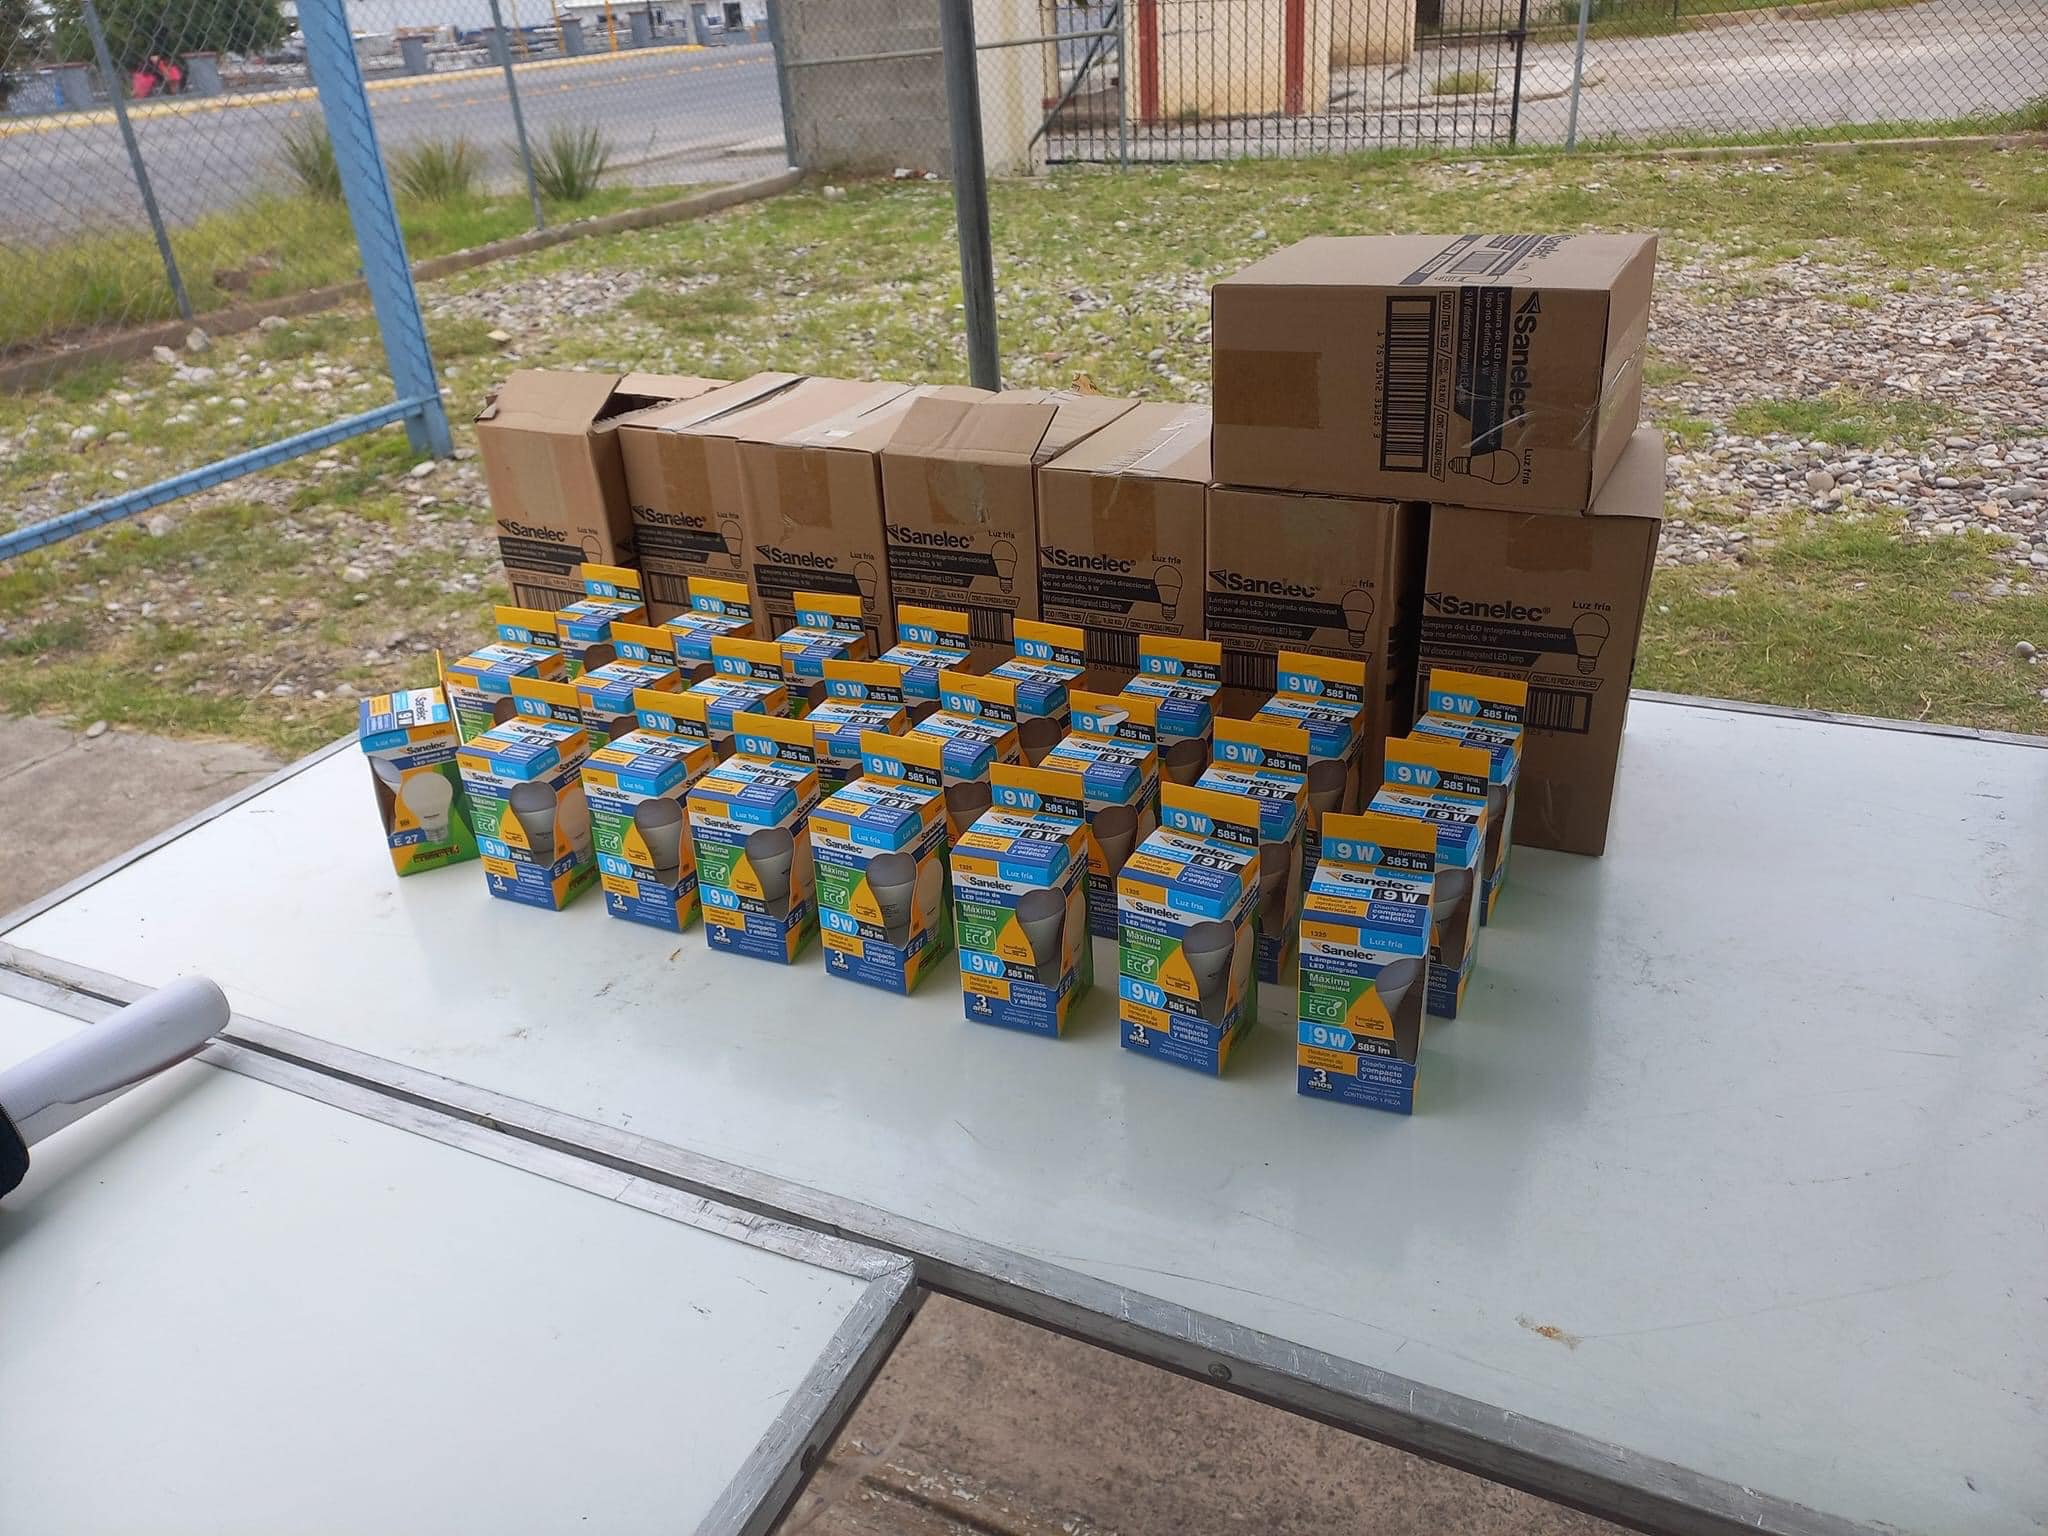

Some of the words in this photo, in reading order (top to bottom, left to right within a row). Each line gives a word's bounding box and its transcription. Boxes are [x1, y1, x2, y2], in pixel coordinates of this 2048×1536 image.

[1376, 344, 1384, 355] 75
[1508, 315, 1537, 421] Sanelec
[1523, 448, 1533, 465] Luz
[645, 508, 704, 528] Sanelec
[511, 522, 565, 542] Sanelec
[900, 527, 970, 548] Sanelec
[771, 548, 834, 569] Sanelec
[1055, 549, 1131, 573] Sanelec
[1443, 596, 1543, 622] Sanelec
[1573, 601, 1591, 609] Luz
[909, 628, 918, 640] 9
[920, 629, 932, 642] W
[1466, 624, 1481, 632] LED
[1024, 643, 1034, 655] 9
[1036, 644, 1047, 658] W
[1056, 653, 1070, 662] 585
[1071, 656, 1081, 665] lm
[723, 660, 732, 672] 9
[734, 660, 746, 674] W
[1151, 660, 1161, 672] 9
[1164, 661, 1177, 674] W
[1186, 669, 1202, 678] 585
[1204, 672, 1215, 680] lm
[836, 683, 846, 696] 9
[848, 684, 861, 697] W
[871, 692, 886, 700] 585
[1289, 677, 1300, 690] 9
[1303, 679, 1317, 693] W
[1326, 688, 1343, 697] 585
[1346, 691, 1357, 701] lm
[951, 696, 960, 710] 9
[963, 698, 975, 712] W
[984, 708, 999, 717] 585
[1001, 711, 1011, 721] lm
[1442, 696, 1454, 710] 9
[1458, 698, 1473, 713] W
[1483, 709, 1502, 719] 585
[1505, 711, 1517, 721] lm
[1083, 716, 1094, 730] 9
[1120, 729, 1137, 738] 585
[1139, 732, 1150, 741] lm
[407, 741, 446, 755] Sanelec
[746, 739, 756, 752] 9
[759, 740, 772, 755] W
[781, 750, 796, 759] 585
[799, 753, 810, 761] lm
[1226, 745, 1238, 759] 9
[1242, 747, 1257, 762] W
[1268, 759, 1285, 768] 585
[1289, 762, 1301, 771] lm
[473, 772, 503, 784] Sanelec
[740, 764, 793, 778] Sanelec
[872, 759, 883, 773] 9
[886, 761, 898, 777] W
[908, 772, 924, 782] 585
[926, 775, 937, 785] lm
[1398, 767, 1411, 782] 9
[1415, 769, 1432, 785] W
[1443, 782, 1463, 791] 585
[1467, 785, 1480, 794] lm
[597, 788, 629, 800] Sanelec
[865, 786, 919, 801] Sanelec
[1004, 790, 1017, 805] 9
[1019, 793, 1034, 808] W
[1045, 805, 1063, 814] 585
[1066, 806, 1078, 816] lm
[477, 821, 495, 831] ECO
[704, 817, 742, 831] Sanelec
[1000, 818, 1061, 832] Sanelec
[1175, 813, 1188, 828] 9
[1191, 817, 1207, 833] W
[1217, 829, 1237, 841] 585
[1239, 833, 1253, 844] lm
[394, 837, 402, 846] E
[405, 834, 418, 844] 27
[600, 838, 618, 849] ECO
[826, 838, 862, 854] Sanelec
[1170, 840, 1235, 860] Sanelec
[1337, 842, 1352, 859] 9
[1357, 845, 1375, 861] W
[1387, 856, 1409, 867] 585
[1413, 858, 1427, 869] lm
[1398, 850, 1427, 859] Ilumina:
[554, 866, 561, 877] E
[561, 859, 572, 872] 27
[1006, 869, 1019, 878] Luz
[493, 874, 503, 887] 3
[704, 870, 724, 881] ECO
[1340, 874, 1414, 890] Sanelec
[969, 876, 1011, 892] Sanelec
[614, 893, 623, 905] 3
[823, 891, 843, 904] ECO
[1175, 898, 1189, 908] Luz
[963, 904, 996, 916] Máxima
[1135, 901, 1179, 921] Sanelec
[1372, 909, 1415, 919] compacto
[716, 925, 726, 937] 3
[1126, 930, 1161, 944] Máxima
[965, 933, 988, 945] ECO
[1369, 938, 1385, 946] Luz
[834, 950, 844, 963] 3
[1321, 945, 1373, 960] Sanelec
[1127, 959, 1150, 974] ECO
[1310, 973, 1350, 987] Máxima
[976, 994, 986, 1007] 3
[1309, 1004, 1337, 1017] ECO
[1133, 1023, 1145, 1038] 3
[1358, 1043, 1375, 1053] 585
[1378, 1045, 1390, 1055] lm
[1313, 1069, 1326, 1082] 3
[1362, 1067, 1402, 1078] compacto
[1308, 1079, 1332, 1089] años
